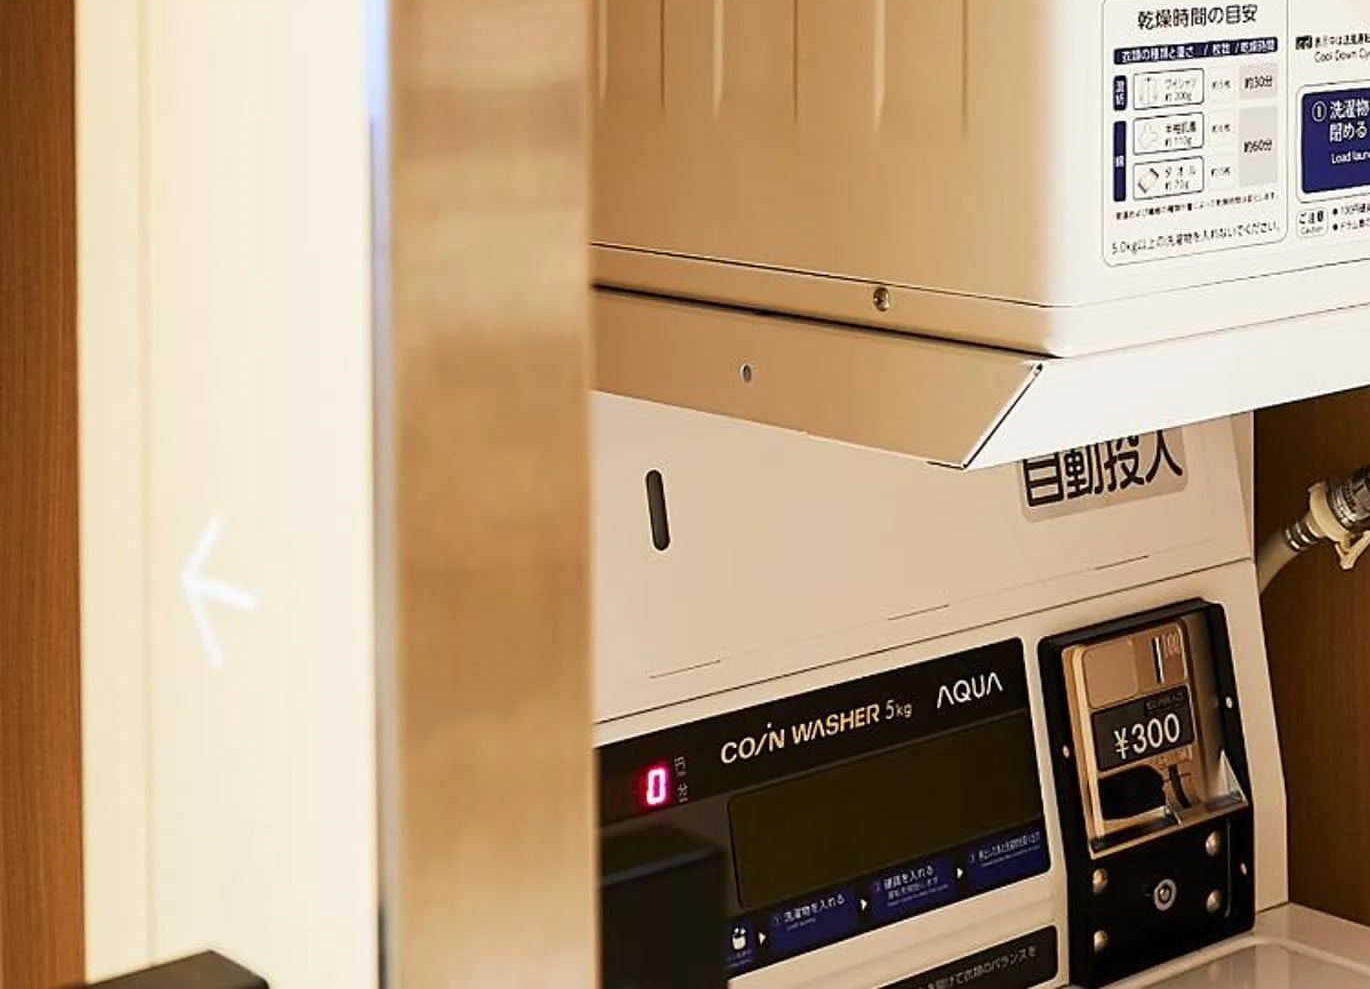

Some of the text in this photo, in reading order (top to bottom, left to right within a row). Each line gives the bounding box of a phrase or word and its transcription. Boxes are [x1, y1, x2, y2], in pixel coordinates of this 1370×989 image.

[1137, 4, 1258, 30] 乾燥時間の目安
[1330, 121, 1368, 142] 閉める
[1331, 152, 1351, 164] Load
[791, 702, 881, 746] WASHER
[885, 700, 914, 722] 5kg
[937, 671, 1004, 709] AQUA
[1114, 712, 1181, 759] ¥300
[646, 767, 667, 806] 0
